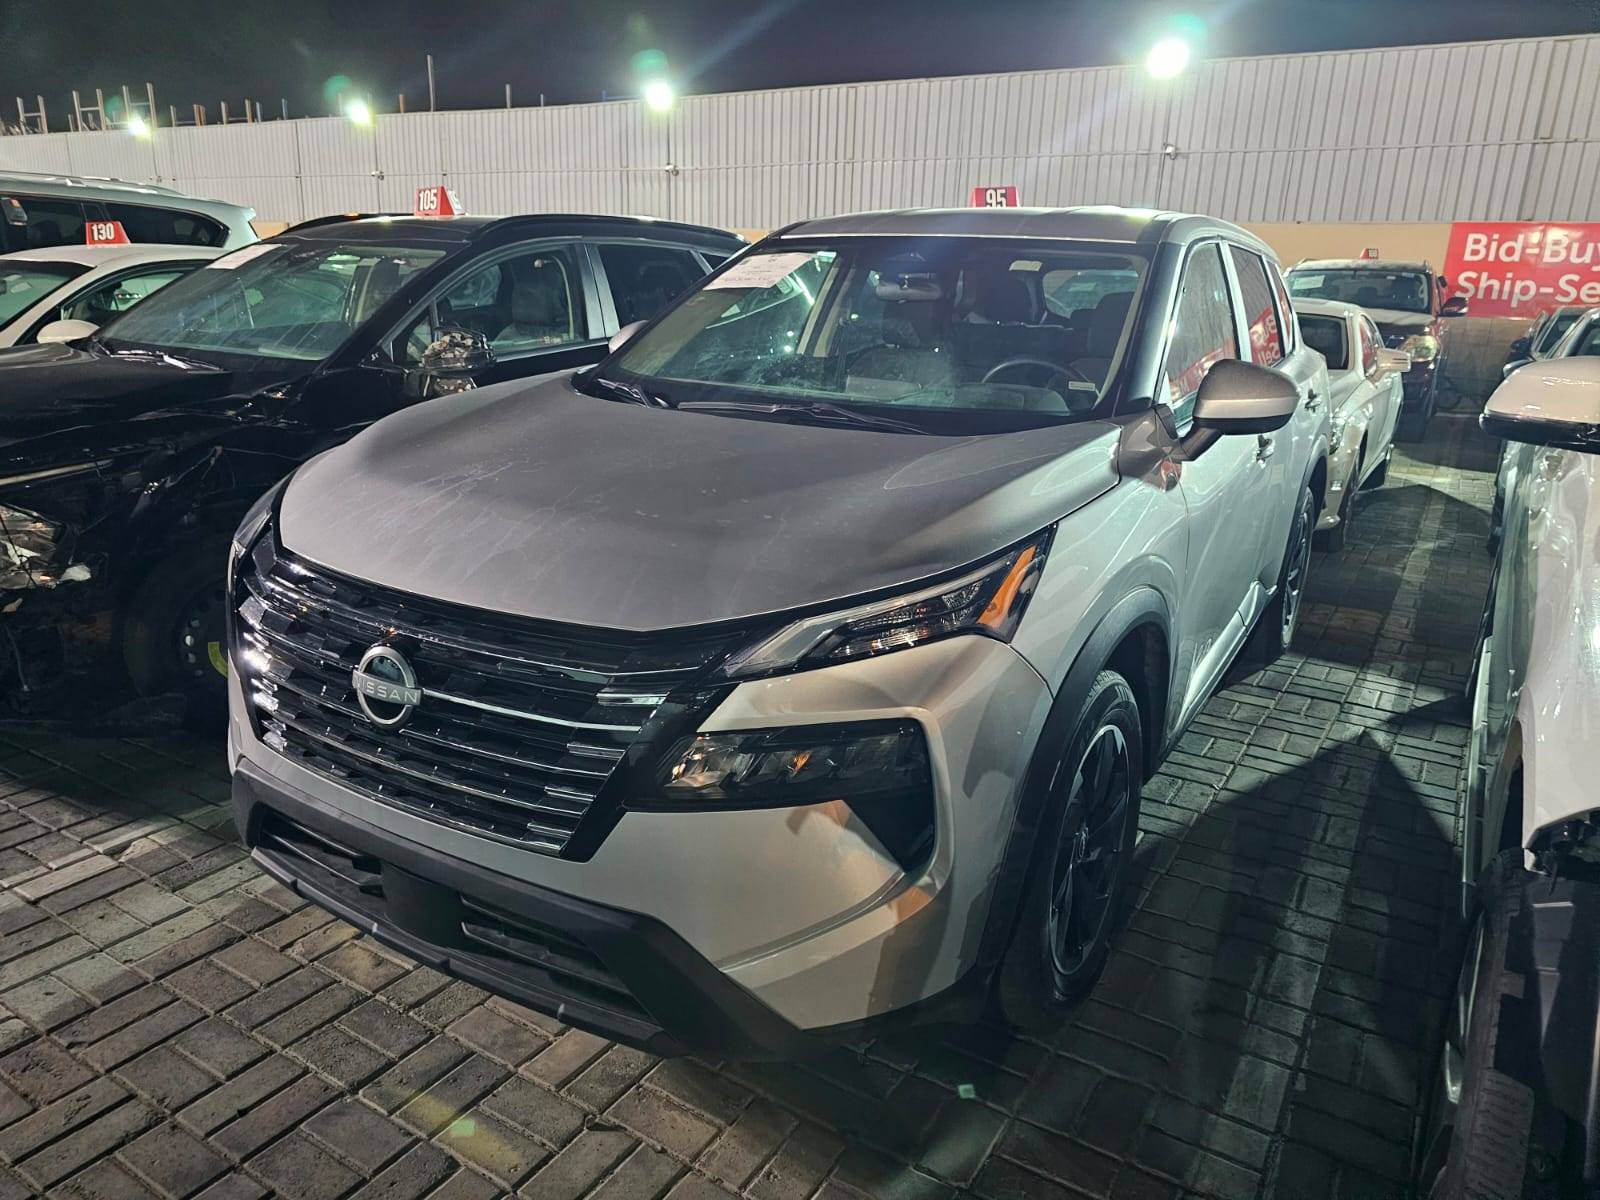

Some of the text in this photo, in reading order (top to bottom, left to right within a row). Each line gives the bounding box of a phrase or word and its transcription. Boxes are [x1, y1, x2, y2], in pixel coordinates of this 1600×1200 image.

[419, 188, 438, 211] 105
[985, 188, 1007, 208] 95
[92, 222, 115, 241] 130
[1463, 231, 1600, 272] Bid-Bu
[352, 672, 418, 704] NISSAN
